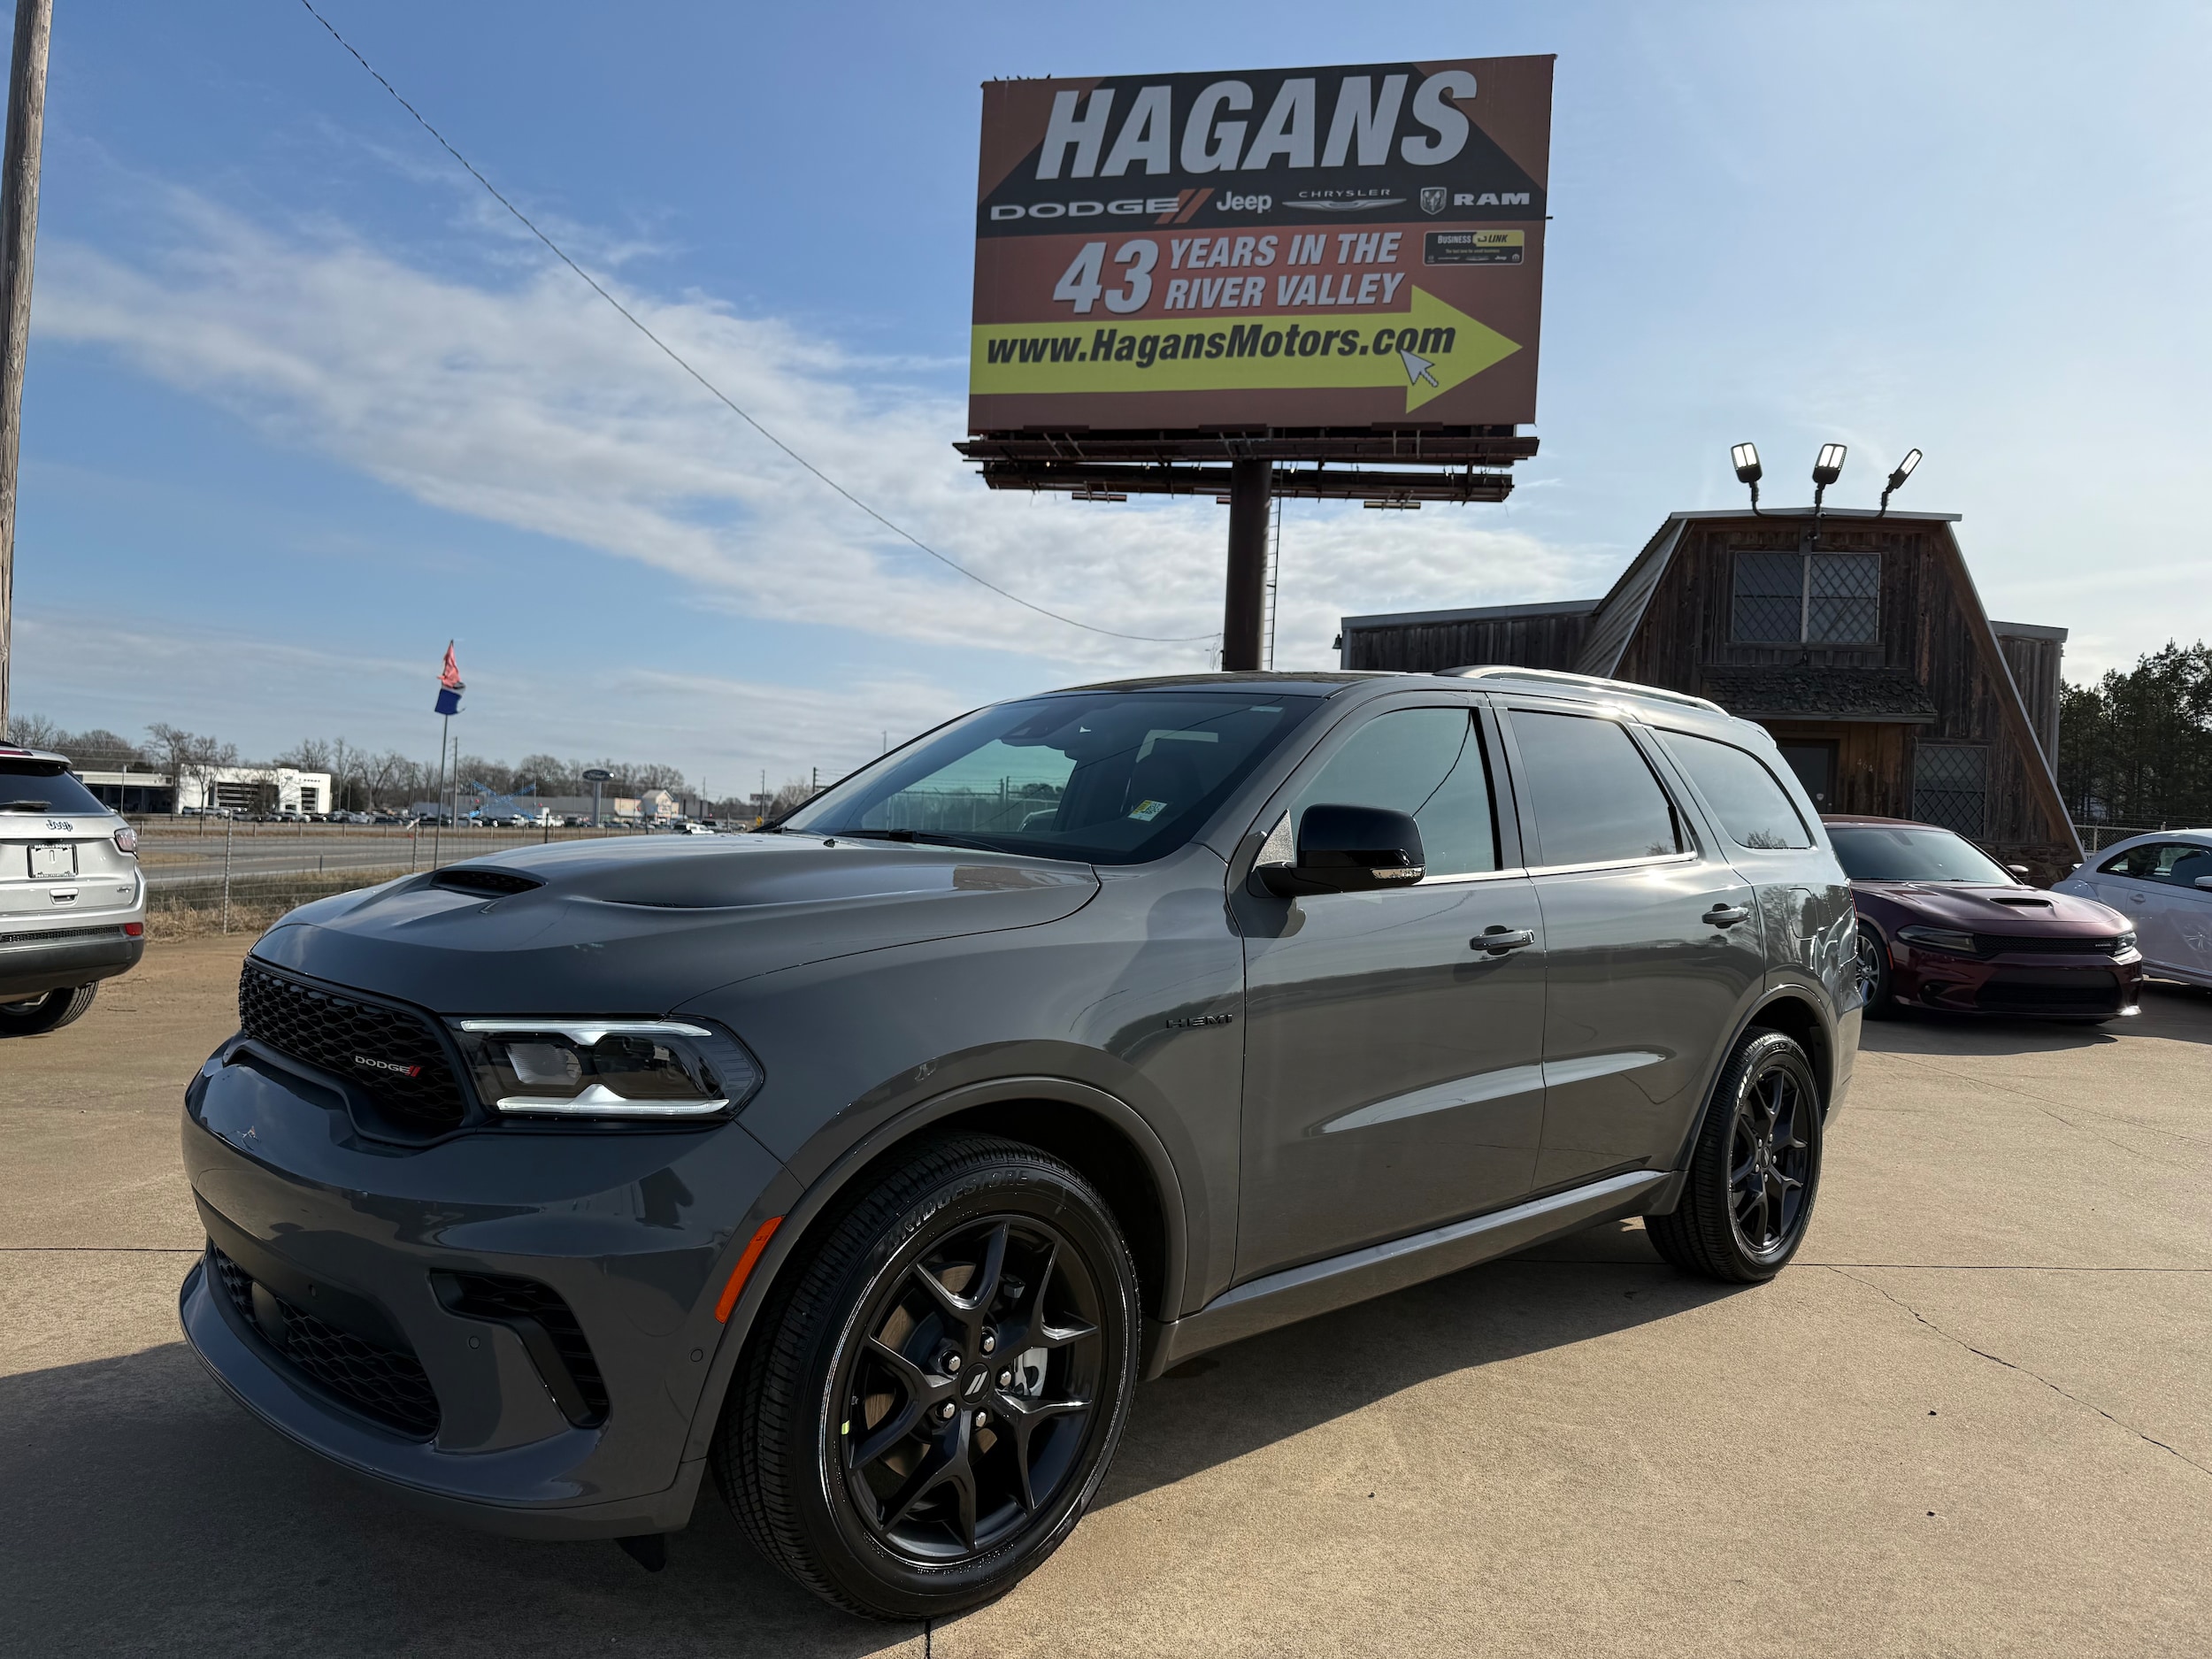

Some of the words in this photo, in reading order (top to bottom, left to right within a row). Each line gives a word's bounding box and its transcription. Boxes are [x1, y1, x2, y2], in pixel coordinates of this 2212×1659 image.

[1035, 70, 1478, 180] HAGANS
[1216, 191, 1271, 213] Jeep
[1298, 188, 1391, 198] CHRYSLER
[1453, 192, 1530, 206] RAM
[990, 197, 1179, 220] DODGE
[1437, 234, 1471, 244] BUSINESS
[1488, 234, 1508, 243] LINK
[1170, 235, 1279, 270] YEARS
[1287, 234, 1327, 265] IN
[1337, 232, 1402, 264] THE
[1052, 239, 1160, 314] 43
[1164, 275, 1266, 310] RIVER
[1277, 273, 1405, 306] VALLEY
[987, 324, 1455, 368] www.HagansMotors.com
[46, 819, 73, 832] Jeep
[1165, 1014, 1233, 1028] HEMI
[355, 1056, 411, 1075] DODGE
